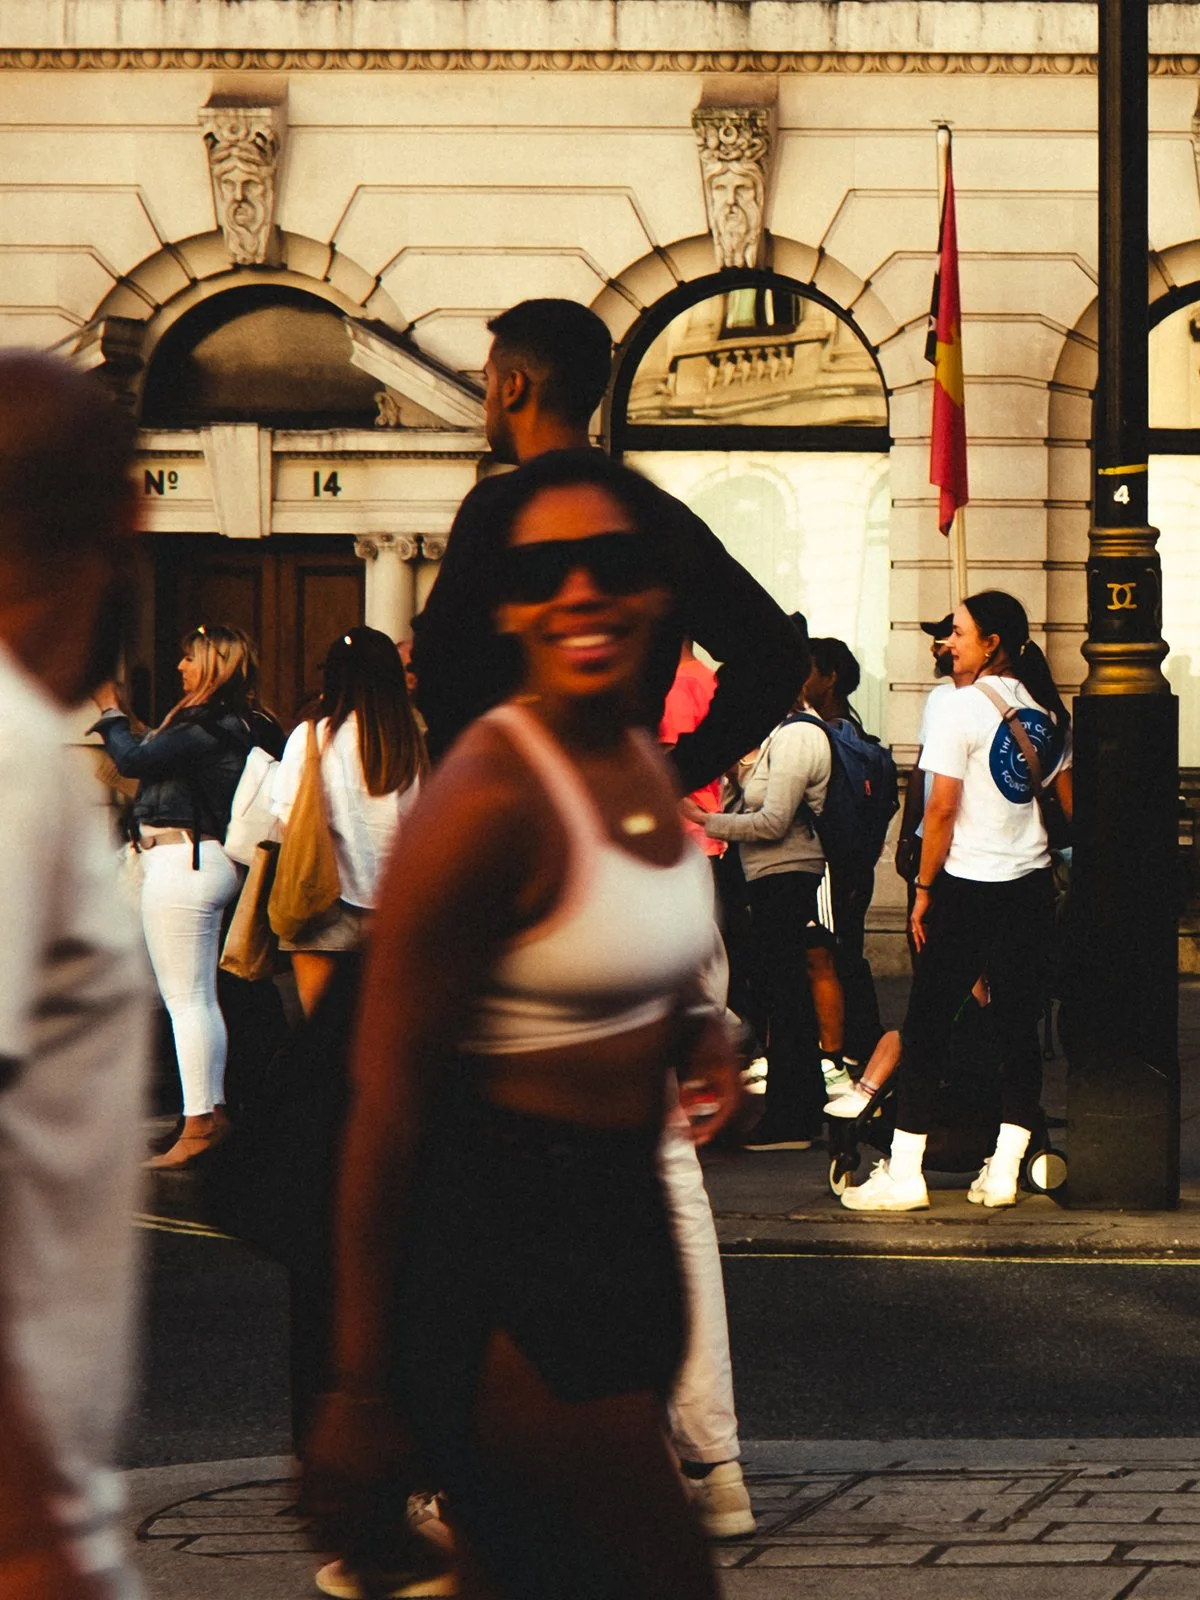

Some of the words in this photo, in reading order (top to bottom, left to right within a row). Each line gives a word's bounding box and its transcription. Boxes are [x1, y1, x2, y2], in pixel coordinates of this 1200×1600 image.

[313, 470, 342, 497] 14
[1113, 484, 1130, 505] 4
[1000, 769, 1030, 793] FOUND
